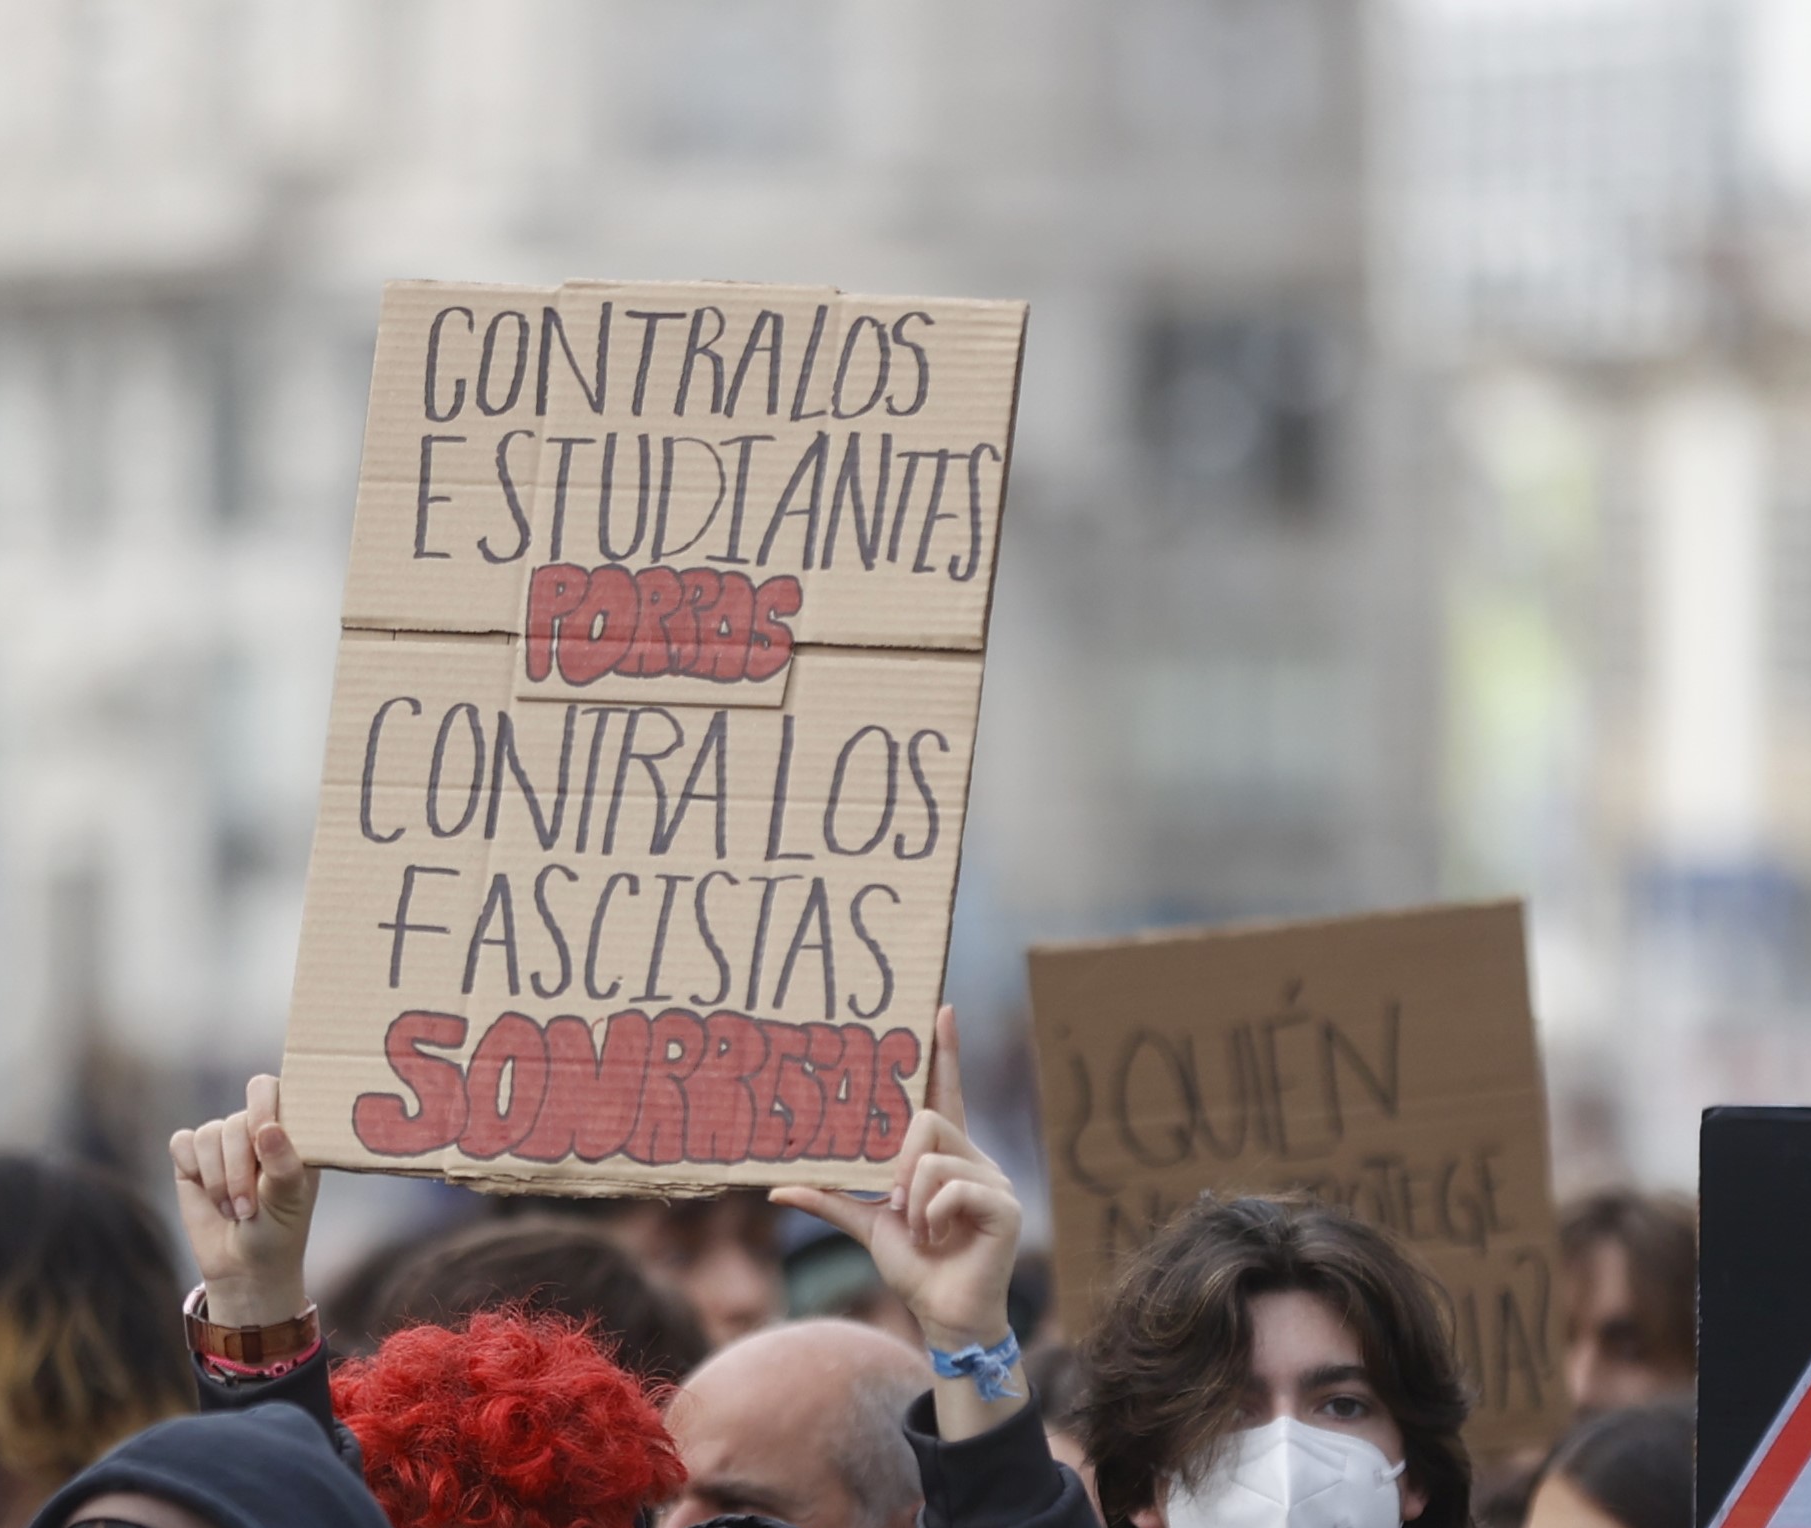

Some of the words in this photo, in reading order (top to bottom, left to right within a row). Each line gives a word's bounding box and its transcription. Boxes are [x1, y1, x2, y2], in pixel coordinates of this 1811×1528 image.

[410, 426, 1003, 584] ESTUDIANTES
[525, 561, 805, 688] PORRAS
[358, 694, 728, 860] CONTRA
[763, 712, 952, 862] LOS
[376, 861, 902, 1021] FASCISTAS
